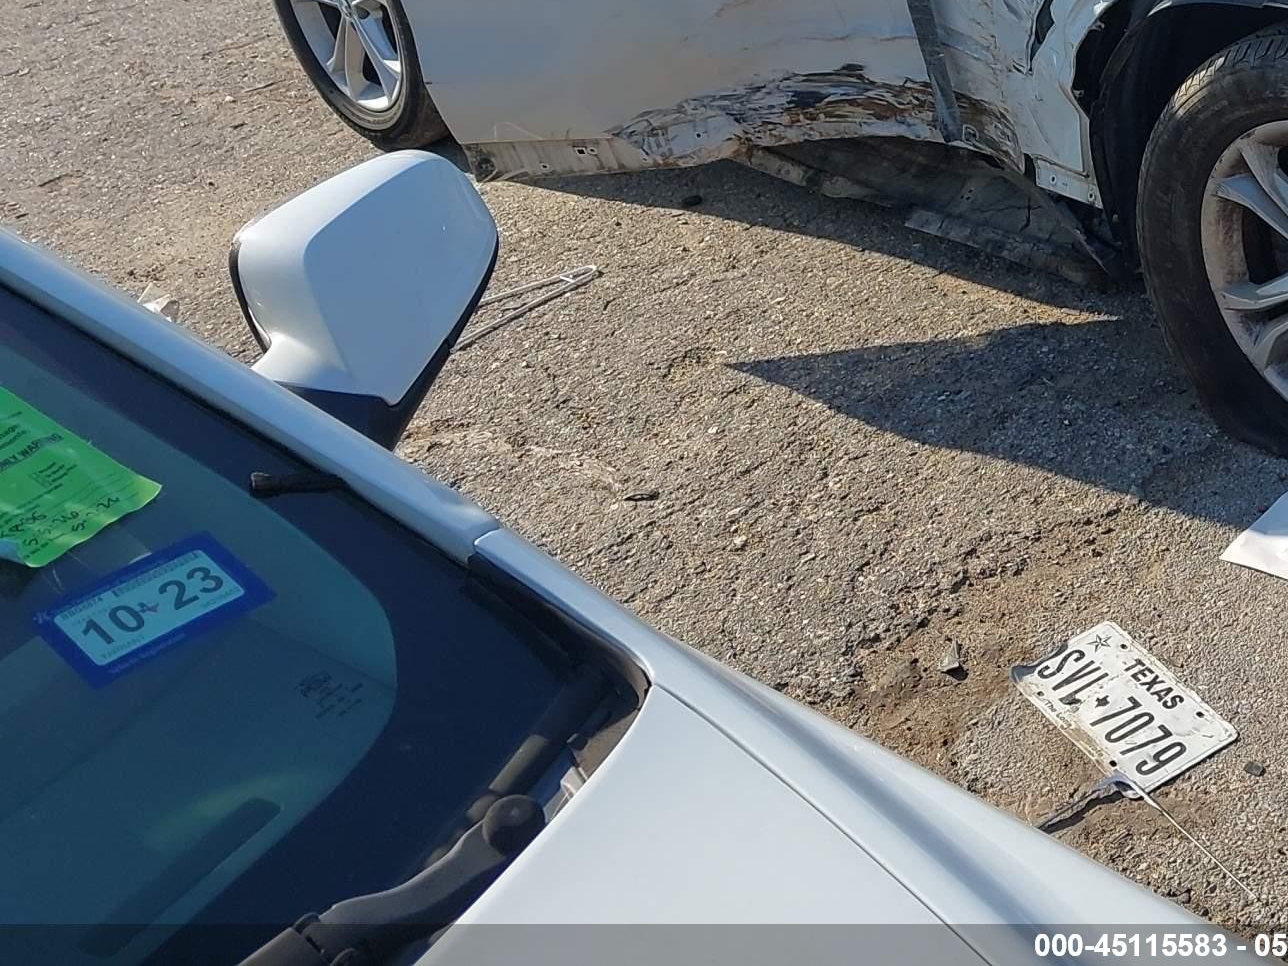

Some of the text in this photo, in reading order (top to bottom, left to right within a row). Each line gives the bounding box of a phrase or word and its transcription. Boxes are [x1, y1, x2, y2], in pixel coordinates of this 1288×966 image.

[82, 605, 145, 645] 10
[158, 566, 224, 611] 23
[1123, 657, 1186, 711] TEXAS
[1090, 695, 1188, 776] 7079
